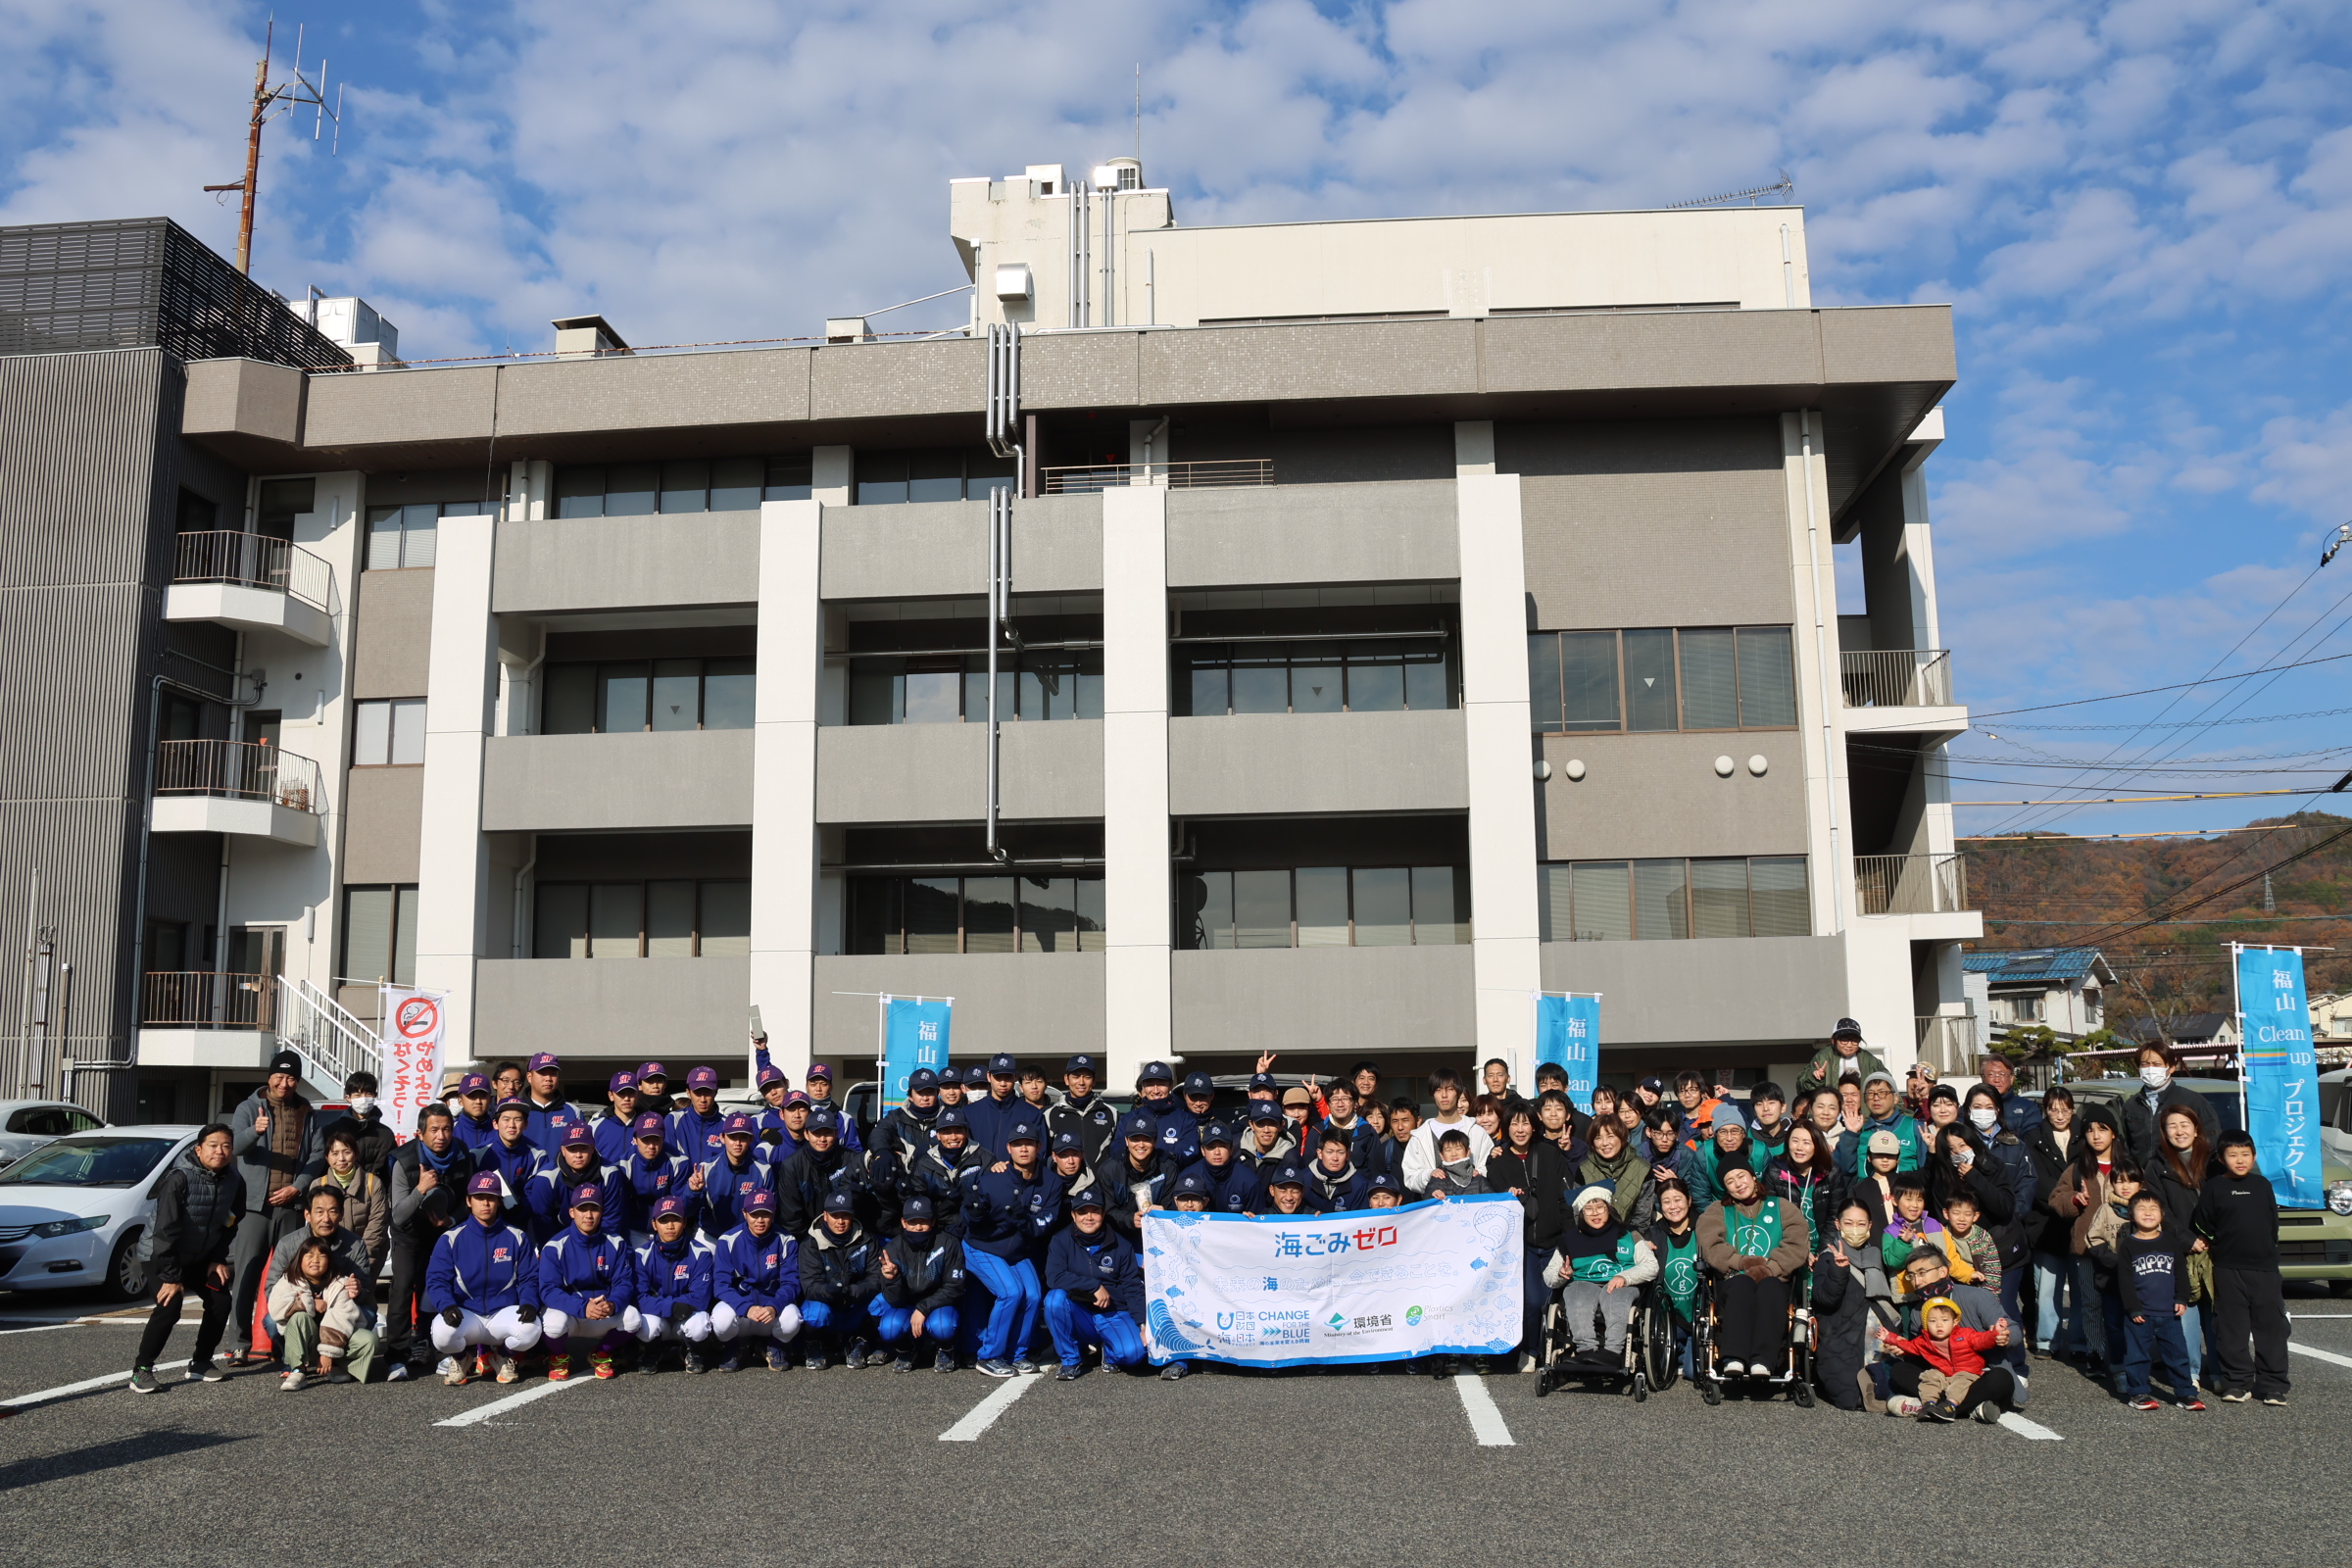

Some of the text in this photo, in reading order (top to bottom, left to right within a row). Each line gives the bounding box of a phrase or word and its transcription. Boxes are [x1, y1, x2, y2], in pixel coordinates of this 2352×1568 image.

[2273, 969, 2295, 1011] 福山
[1567, 1017, 1587, 1061] 福山
[2259, 1026, 2306, 1042] Clean
[918, 1020, 938, 1064] 福山
[2290, 1051, 2311, 1065] up
[1568, 1079, 1591, 1092] ean
[2283, 1078, 2306, 1188] プロジェクト
[1275, 1226, 1397, 1257] 海ごみゼロ
[952, 1269, 963, 1279] 24
[1213, 1261, 1459, 1292] 未来の海のために、今できることを。
[1236, 1311, 1254, 1320] 日本
[1258, 1310, 1310, 1321] CHANGE
[1353, 1314, 1392, 1329] 環境省
[1283, 1329, 1310, 1338] BLUE
